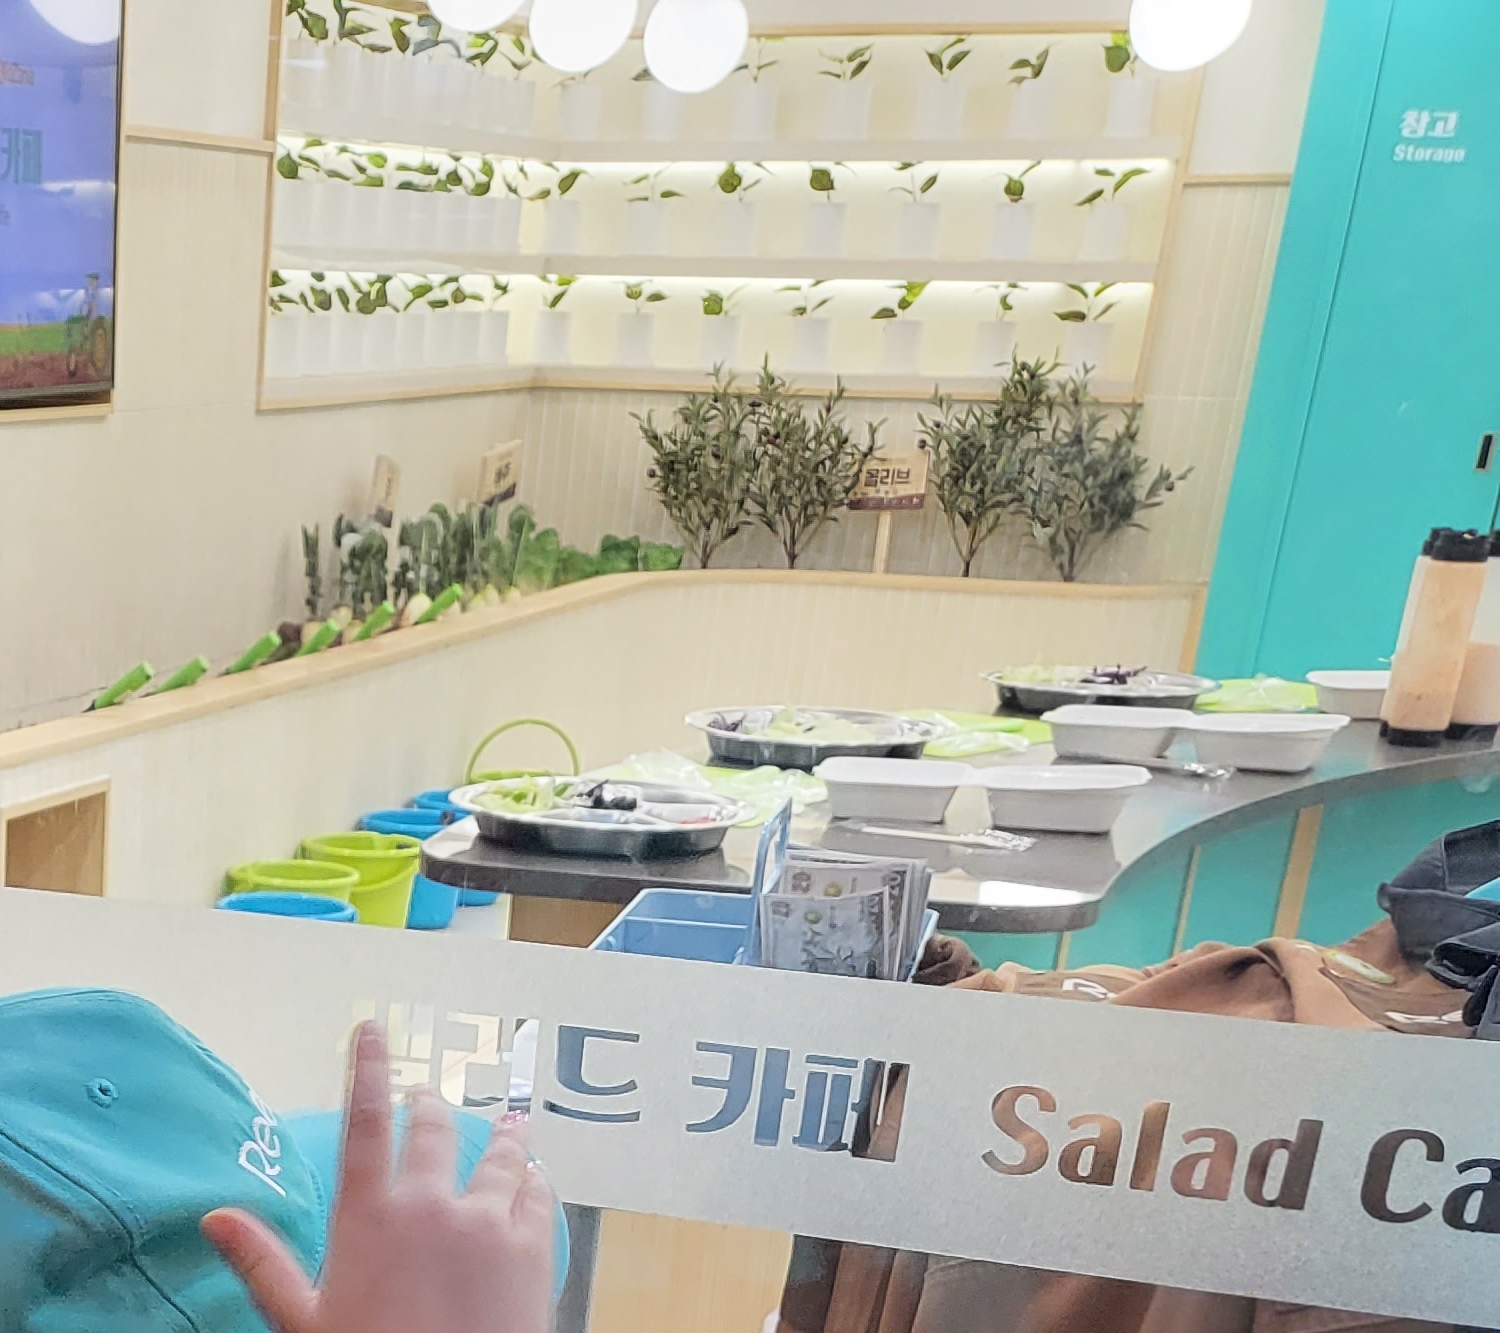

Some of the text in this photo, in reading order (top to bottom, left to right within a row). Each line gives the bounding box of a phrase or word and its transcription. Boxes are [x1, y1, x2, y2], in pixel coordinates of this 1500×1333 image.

[1393, 144, 1466, 163] Storage
[1400, 109, 1458, 138] 창고
[686, 1041, 911, 1163] 카페
[981, 1085, 1324, 1210] Salad
